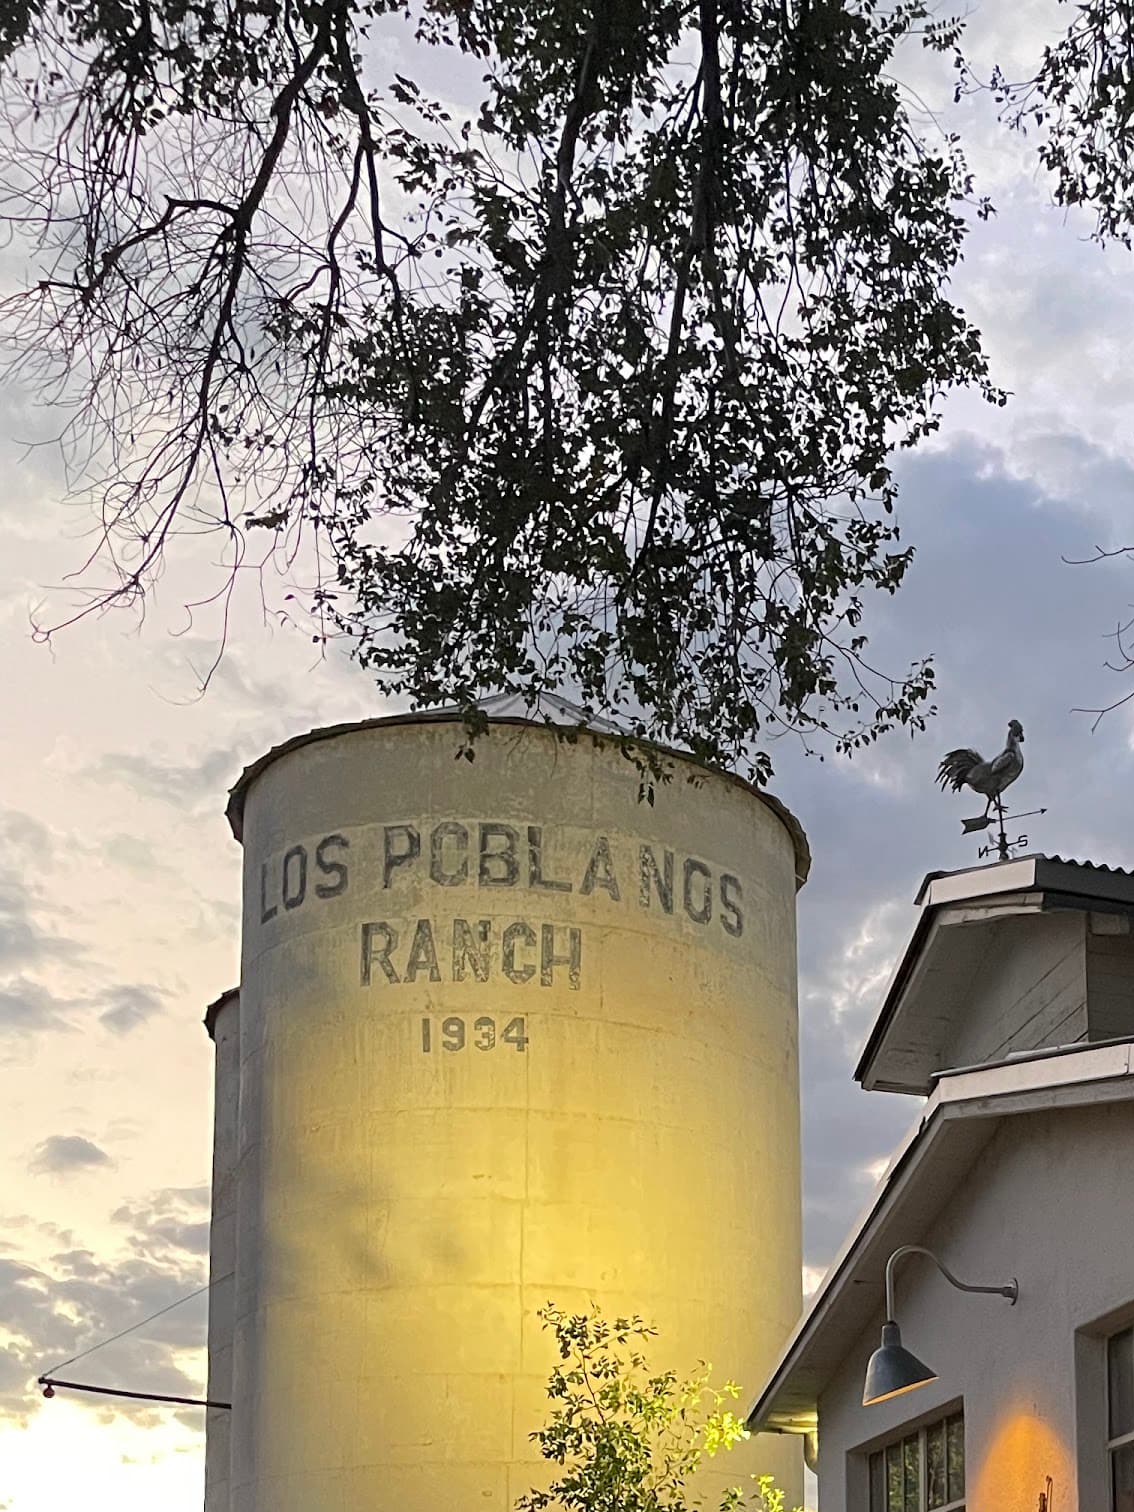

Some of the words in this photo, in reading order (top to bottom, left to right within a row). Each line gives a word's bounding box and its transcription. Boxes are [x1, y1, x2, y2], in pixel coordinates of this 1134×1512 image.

[261, 833, 349, 924] LOS
[382, 821, 743, 938] POBLANOS
[360, 918, 581, 991] RANCH
[422, 1016, 529, 1053] 1934
